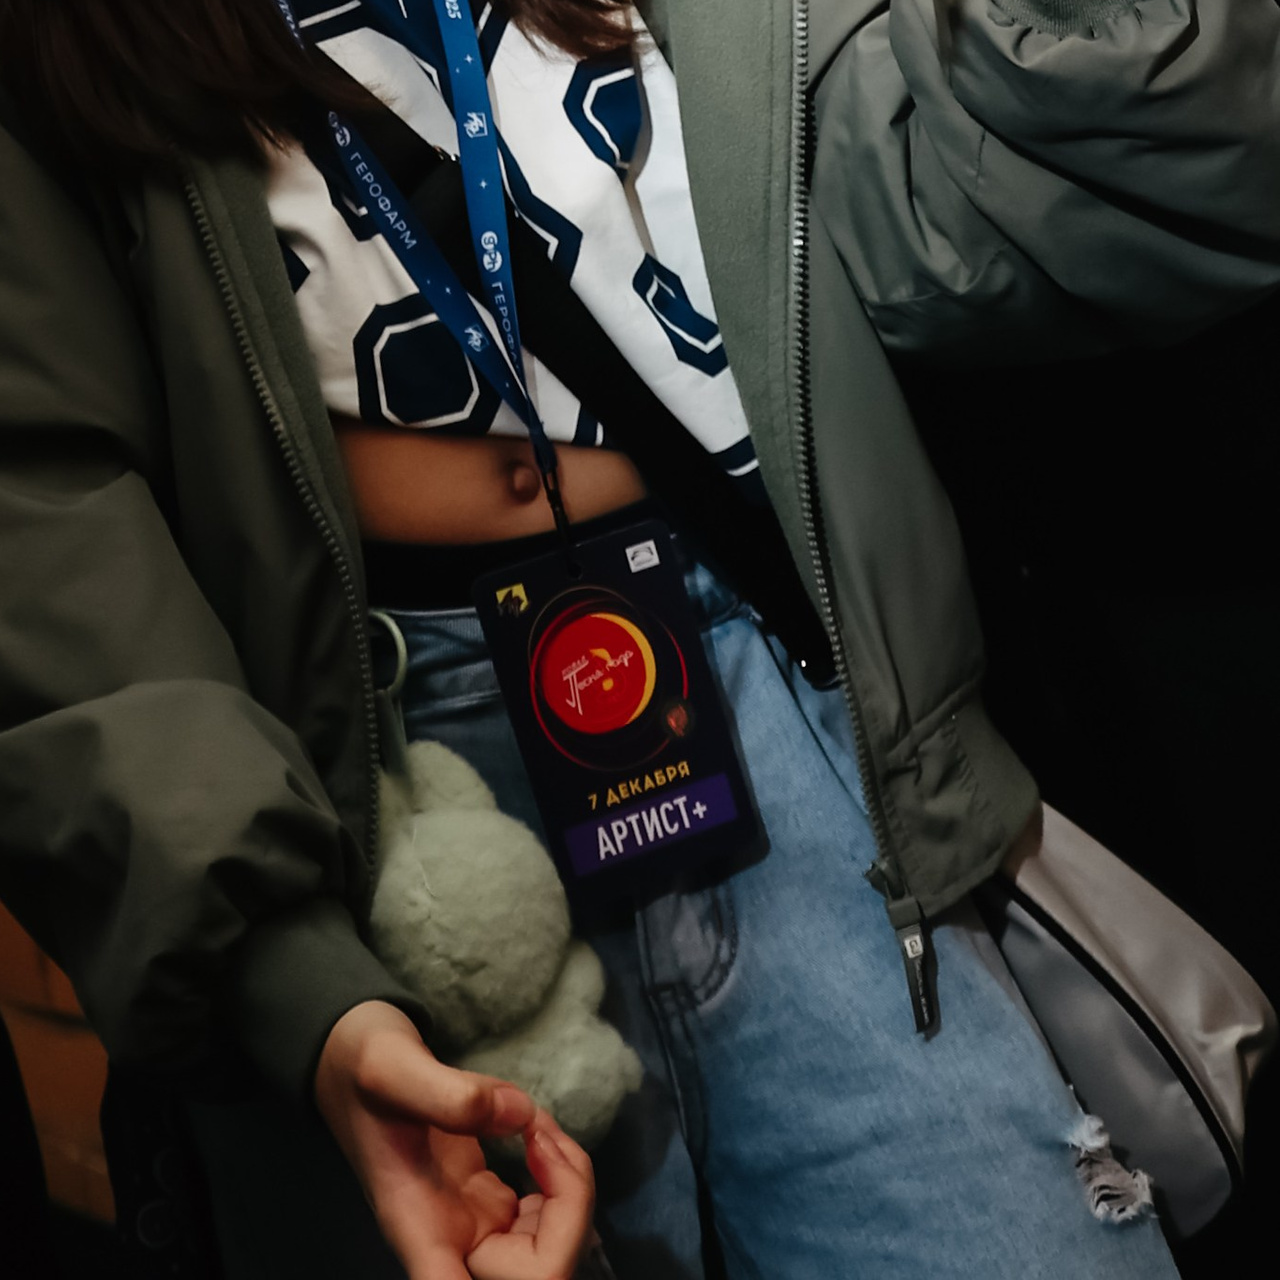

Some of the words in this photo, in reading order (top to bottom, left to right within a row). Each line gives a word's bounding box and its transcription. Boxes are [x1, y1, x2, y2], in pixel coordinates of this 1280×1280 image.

[350, 152, 417, 250] ГЕРОФАРМ
[588, 793, 598, 811] 7
[606, 761, 690, 807] ДЕКАБРЯ
[597, 795, 708, 860] АРТИСТ+
